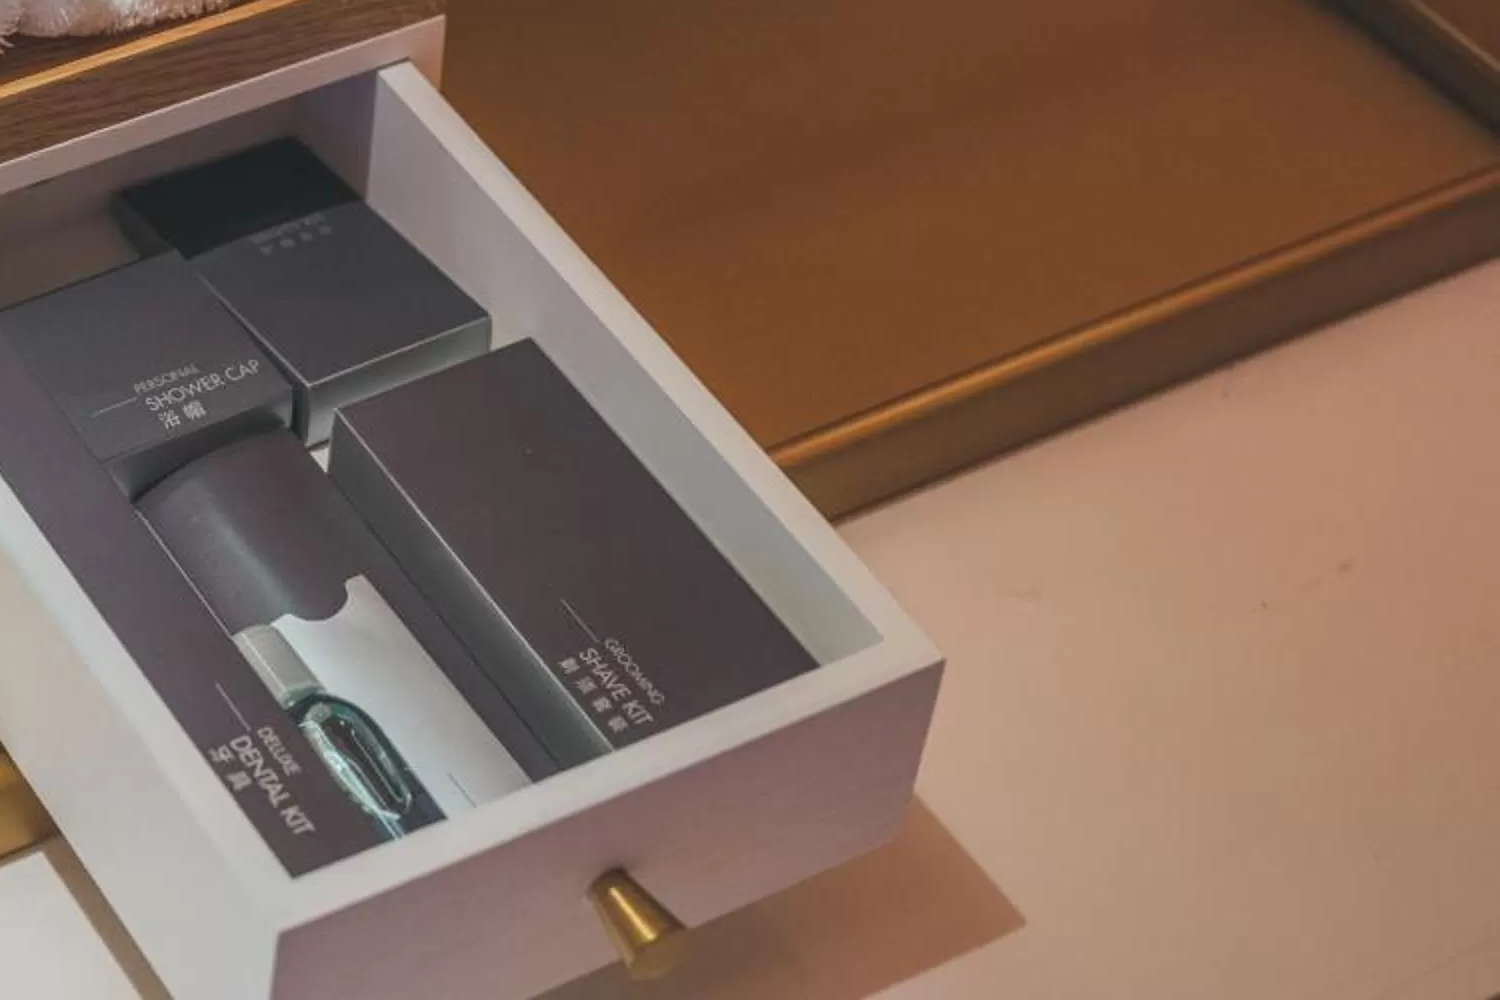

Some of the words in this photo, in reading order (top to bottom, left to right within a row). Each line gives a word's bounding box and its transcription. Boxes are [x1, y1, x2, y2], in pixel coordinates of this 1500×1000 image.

[132, 363, 200, 394] PERSONAL
[145, 373, 225, 411] SHOWER
[224, 359, 260, 381] CAP
[579, 647, 632, 701] SHAVE
[621, 700, 654, 725] KIT
[604, 638, 665, 705] GROOMING
[229, 735, 291, 809] DENTAL
[280, 805, 317, 835] KIT
